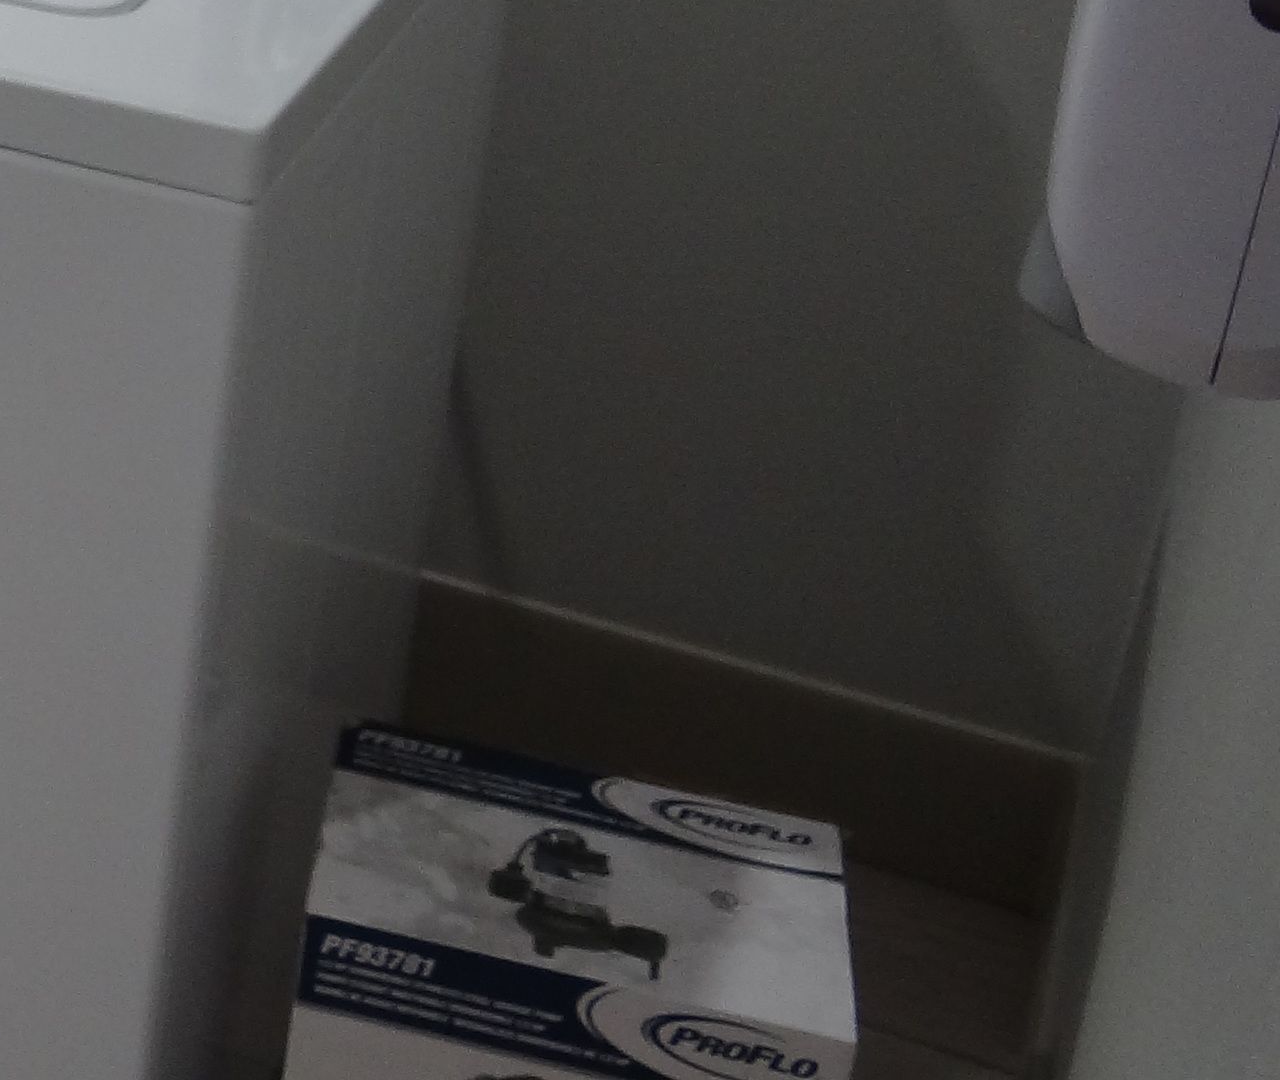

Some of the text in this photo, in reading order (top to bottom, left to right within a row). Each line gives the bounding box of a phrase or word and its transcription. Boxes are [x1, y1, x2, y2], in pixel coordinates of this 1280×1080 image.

[678, 806, 814, 846] PROFLO
[320, 933, 437, 978] PF93781
[669, 1027, 820, 1079] PROFLO
